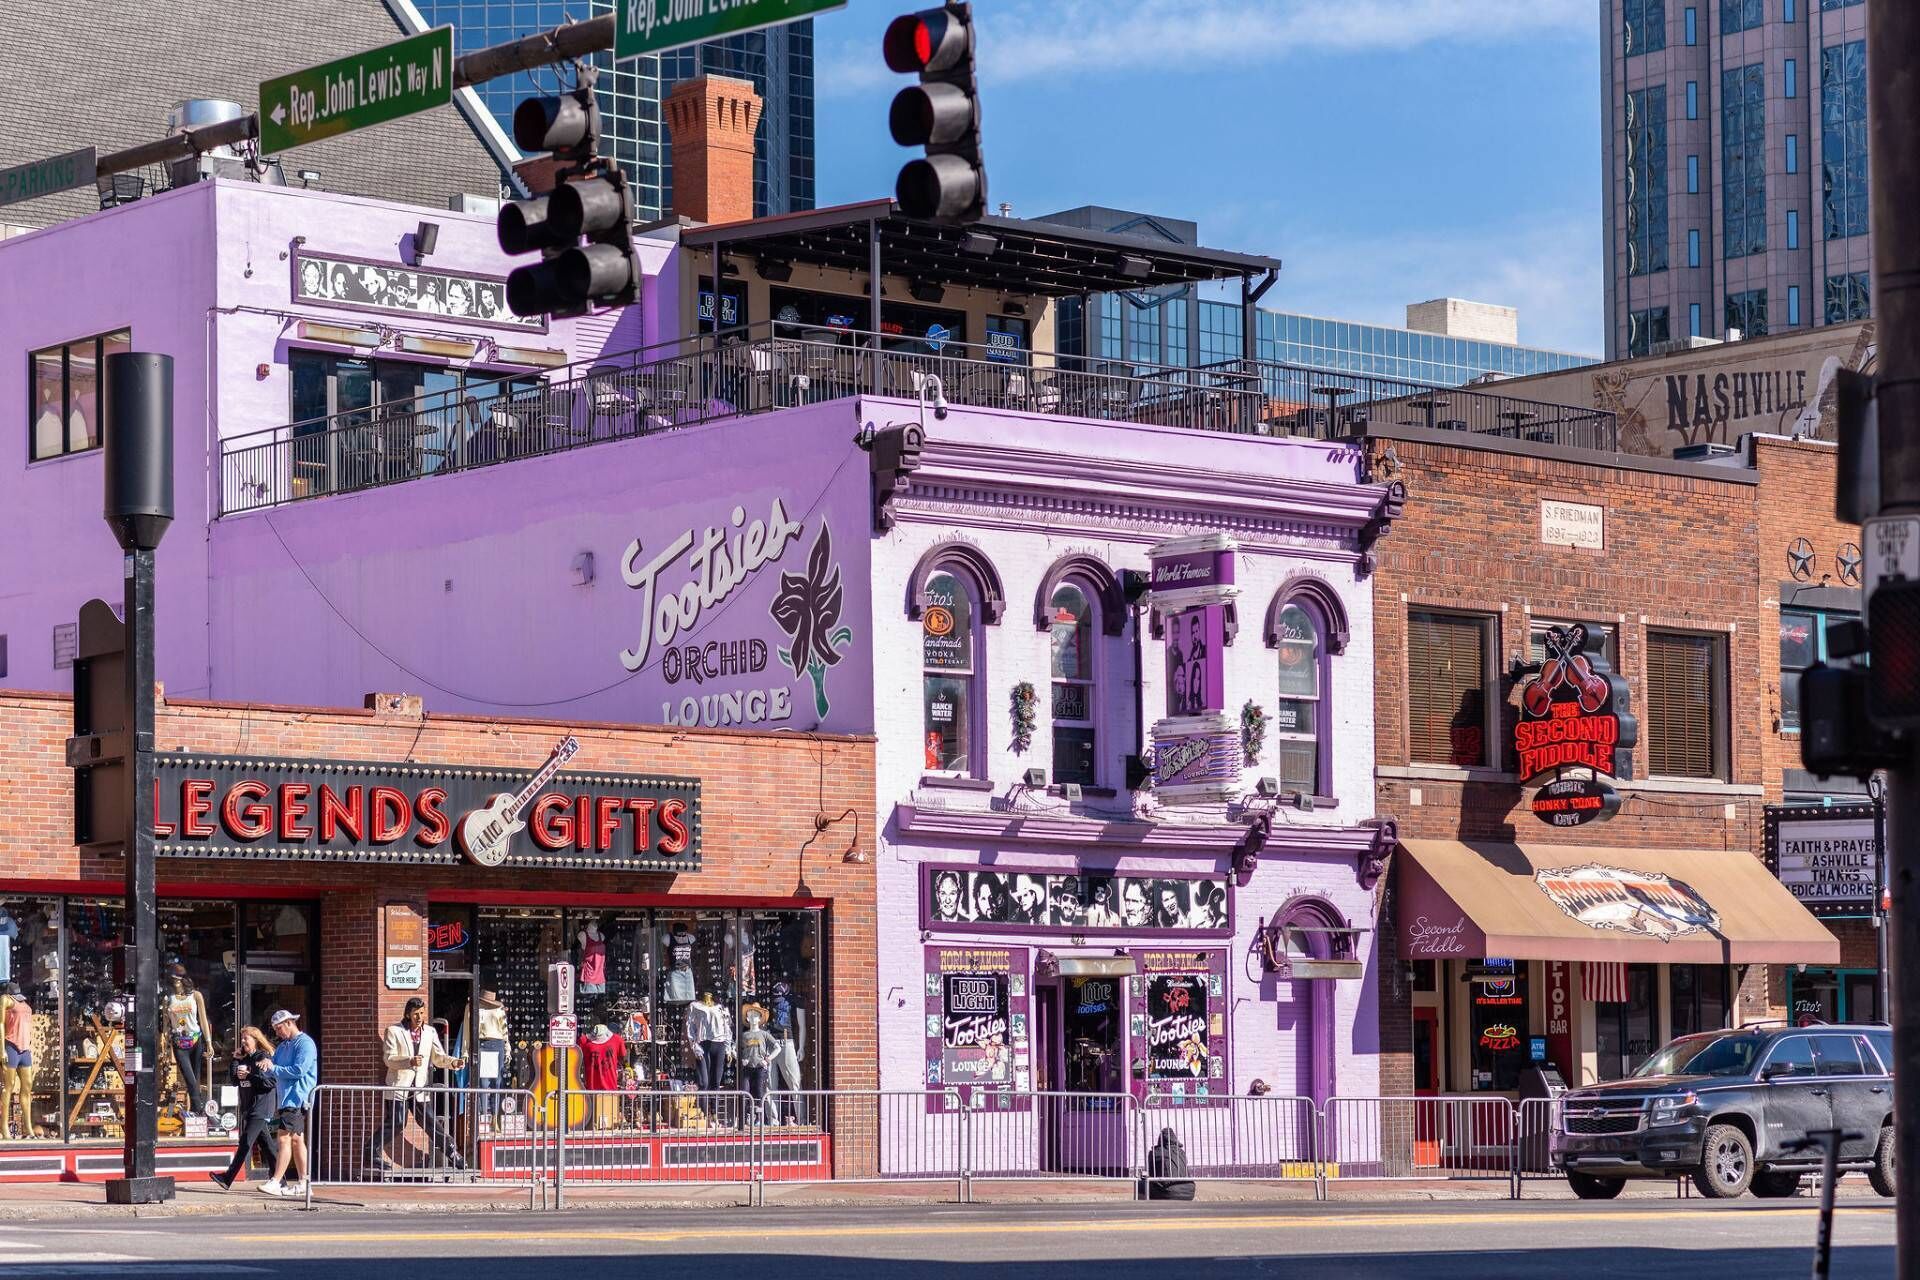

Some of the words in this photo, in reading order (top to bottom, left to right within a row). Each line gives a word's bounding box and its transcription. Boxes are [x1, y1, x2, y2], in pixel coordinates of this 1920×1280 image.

[626, 0, 661, 39] Rep.
[290, 84, 320, 131] Rep.
[321, 71, 355, 118] John
[359, 56, 402, 106] Lewis
[407, 62, 428, 96] Way
[432, 46, 443, 90] N
[8, 158, 75, 195] PARKING
[705, 295, 730, 310] BD
[991, 333, 1014, 347] BUD
[1665, 369, 1807, 430] NASHVILLE
[1156, 563, 1181, 583] World
[1181, 562, 1212, 580] Famous
[619, 497, 805, 673] Tootsies
[662, 638, 769, 685] ORCHID
[662, 686, 793, 728] LOUNGE
[931, 702, 953, 711] RANCH
[931, 709, 953, 718] WATER
[1551, 701, 1580, 719] THE
[1514, 715, 1619, 751] SECOND
[1520, 742, 1613, 781] FIDDLE
[1183, 768, 1209, 780] LOUNGE
[1531, 799, 1569, 811] HONKY
[1570, 796, 1601, 809] TONK
[154, 776, 451, 845] LEGENDS
[528, 792, 691, 856] GIFTS
[1785, 840, 1821, 854] FAITH
[1823, 840, 1832, 853] &
[1811, 869, 1861, 881] THANKS
[1544, 880, 1629, 918] SECOND
[1410, 916, 1465, 936] Second
[1409, 935, 1466, 956] Fiddle
[940, 950, 971, 971] WORLD
[973, 950, 1010, 971] FAMOUS
[1143, 953, 1174, 971] WORLD
[391, 976, 406, 984] ENTER
[406, 976, 417, 984] HERE
[958, 980, 989, 996] BUD
[1080, 981, 1113, 1006] Lite
[1795, 1000, 1822, 1013] Tito's
[944, 1014, 1007, 1048] Tootsies
[1149, 1013, 1207, 1046] Tootsies
[1550, 1019, 1568, 1034] BAR
[1480, 1035, 1521, 1050] PIZZA
[1531, 1042, 1545, 1050] ATM
[1154, 1058, 1190, 1070] LOUNGE
